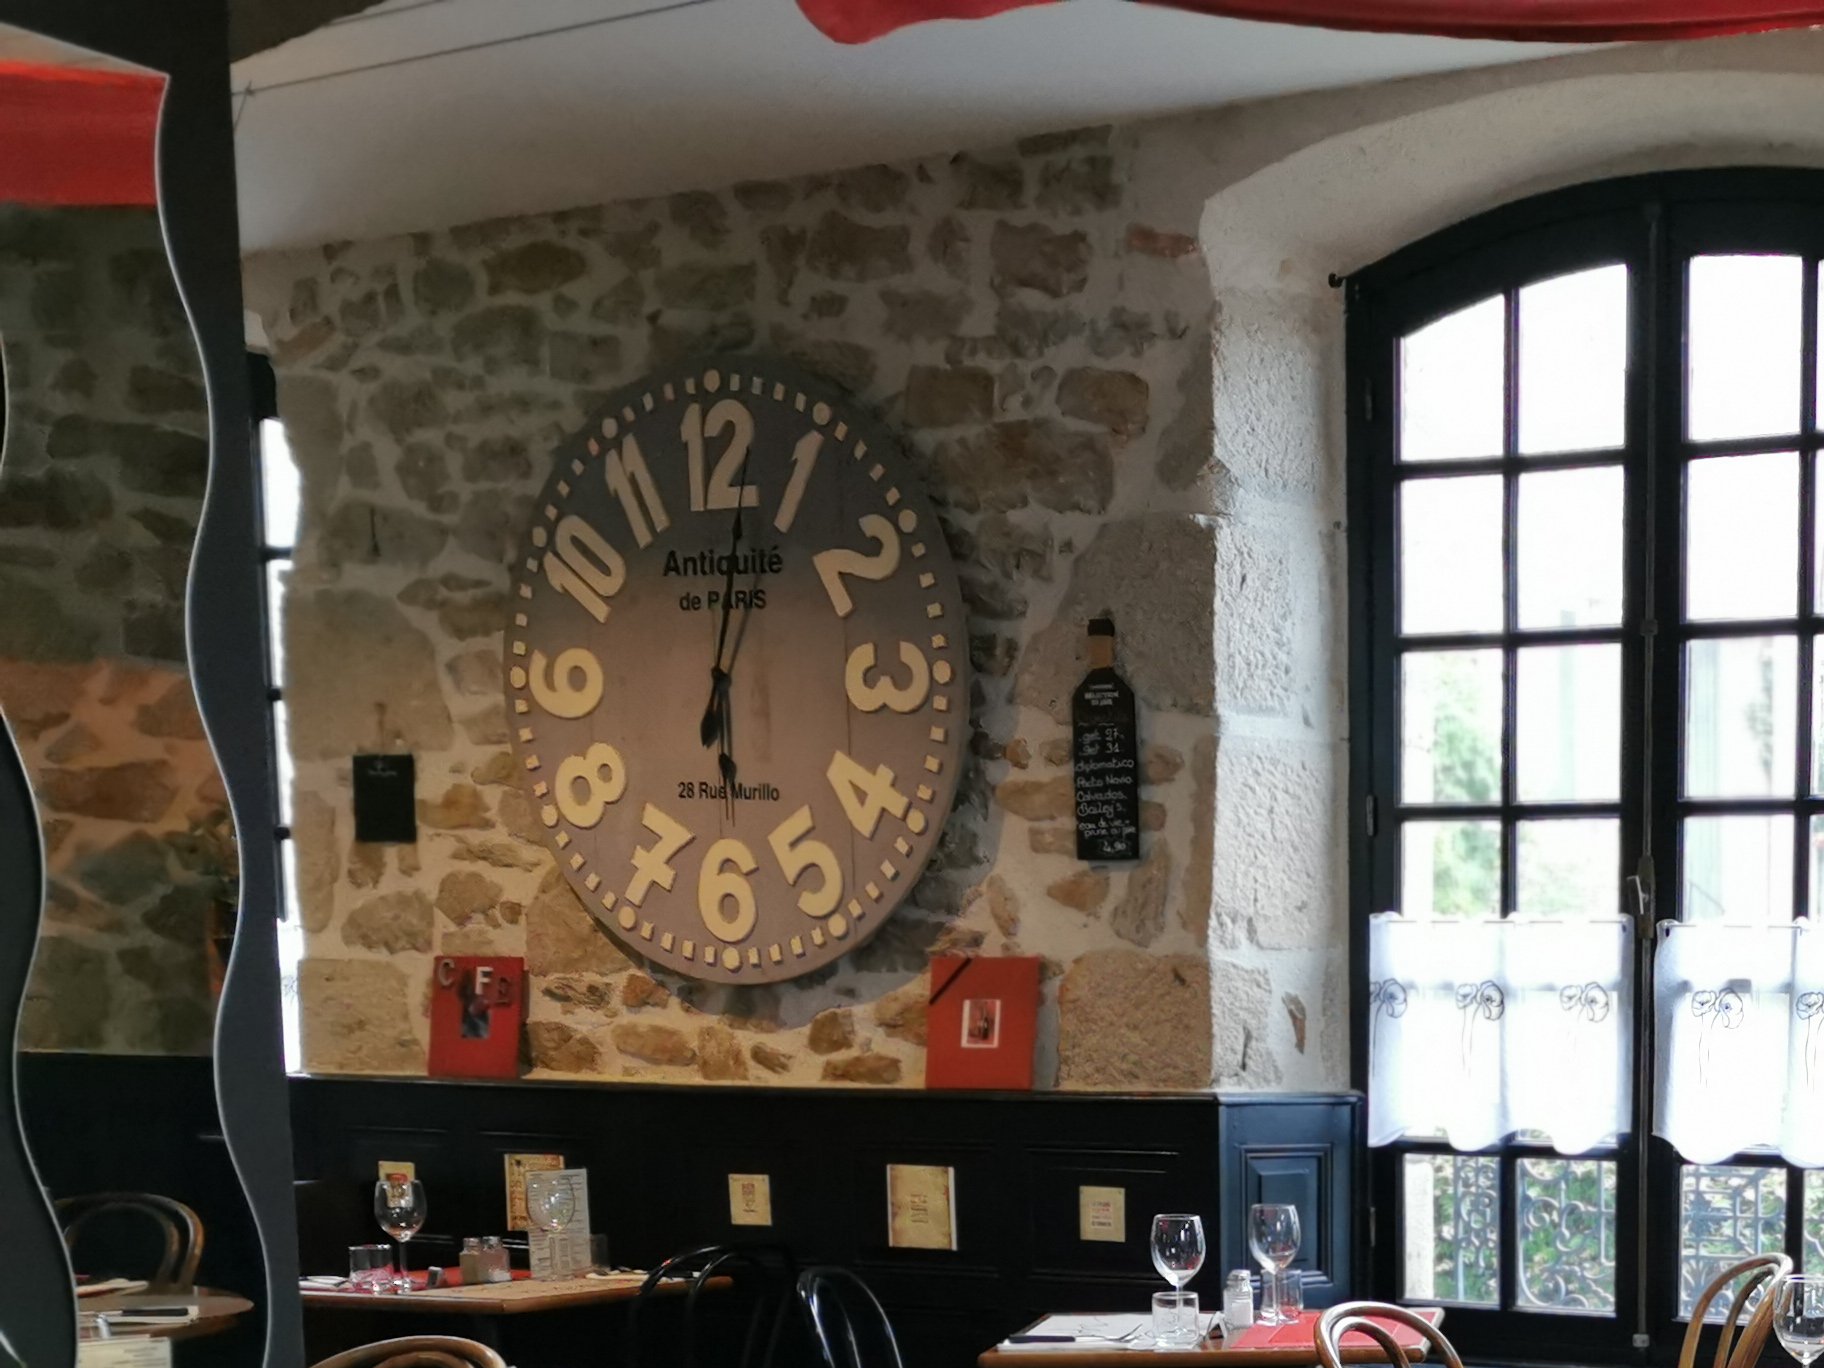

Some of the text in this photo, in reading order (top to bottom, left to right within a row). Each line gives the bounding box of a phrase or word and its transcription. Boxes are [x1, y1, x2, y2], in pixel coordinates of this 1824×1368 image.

[605, 433, 670, 548] 11
[680, 399, 759, 511] 12
[773, 430, 825, 533] 1
[543, 514, 626, 623] 10
[662, 545, 783, 580] Antiquité
[679, 592, 701, 611] de
[812, 513, 899, 617] 2
[845, 641, 930, 712] 3
[554, 742, 627, 827] 8
[678, 781, 780, 801] 28 Rue Murillo
[826, 750, 909, 837] 4
[625, 802, 695, 905] 7
[699, 838, 758, 942] 6
[767, 804, 842, 916] 5
